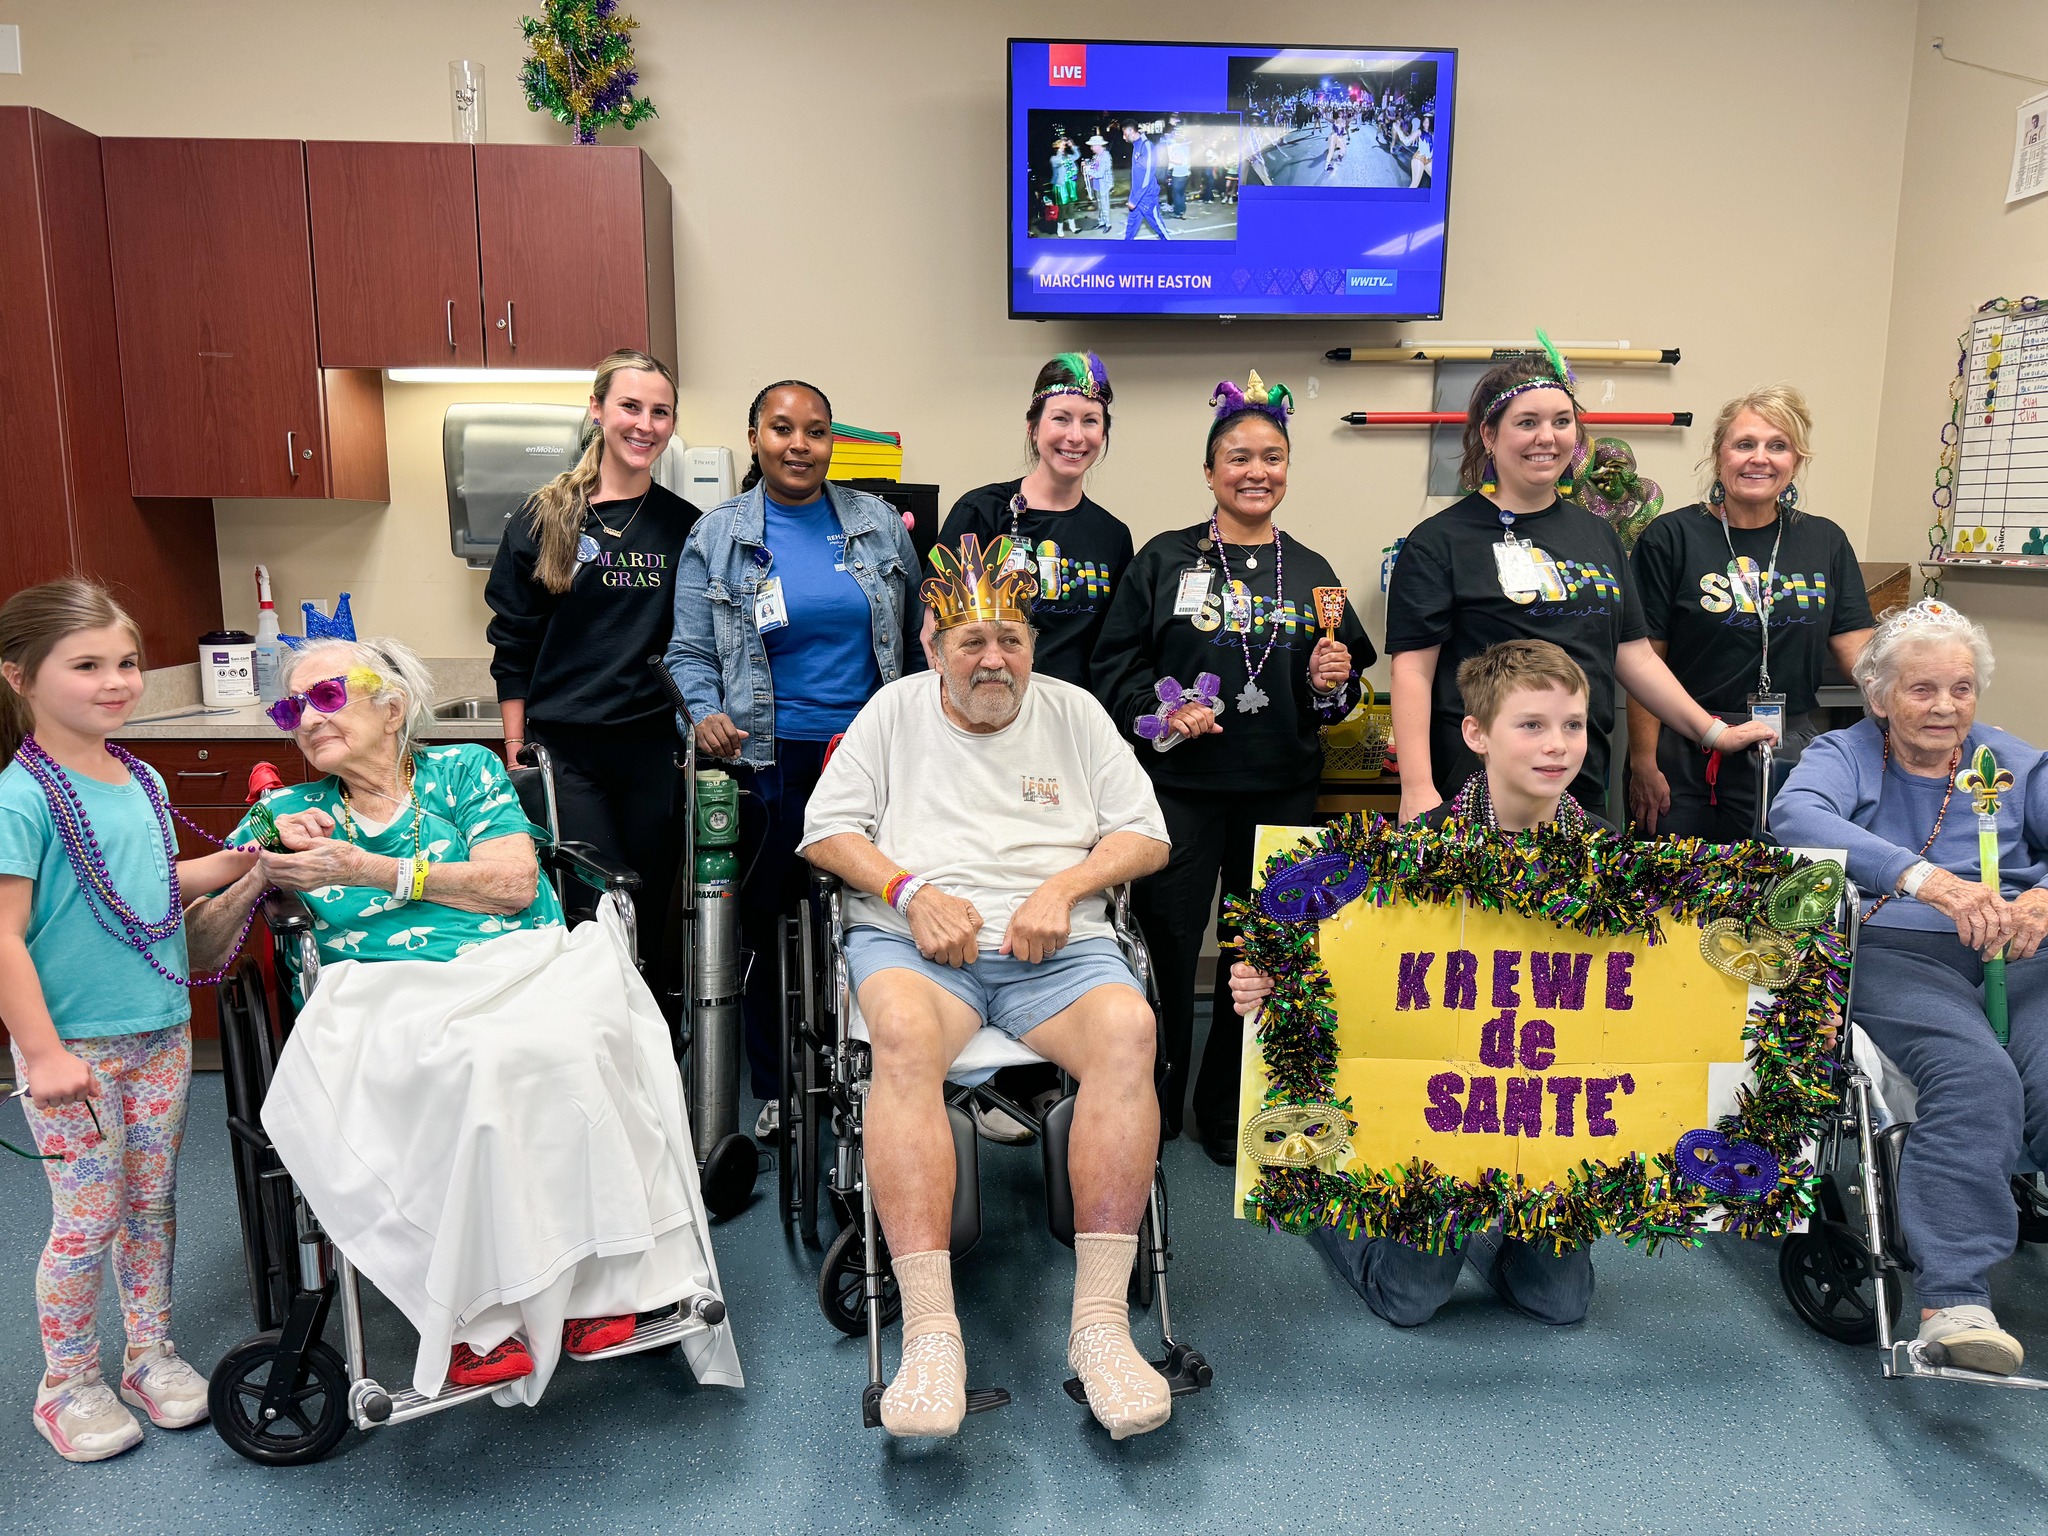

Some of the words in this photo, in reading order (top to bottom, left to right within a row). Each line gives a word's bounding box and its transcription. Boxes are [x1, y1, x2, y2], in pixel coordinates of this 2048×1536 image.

[1053, 65, 1082, 79] LIVE
[1039, 274, 1115, 288] MARCHING
[1118, 275, 1154, 288] WITH
[1157, 275, 1212, 289] EASTON
[525, 446, 565, 454] enMotion
[826, 533, 848, 541] REHA
[595, 551, 668, 569] MARDI
[602, 571, 661, 587] GRAS
[1208, 625, 1302, 651] krwe
[695, 890, 725, 899] RAXAIR
[1395, 949, 1636, 1012] KREWE
[1478, 1008, 1557, 1071] de
